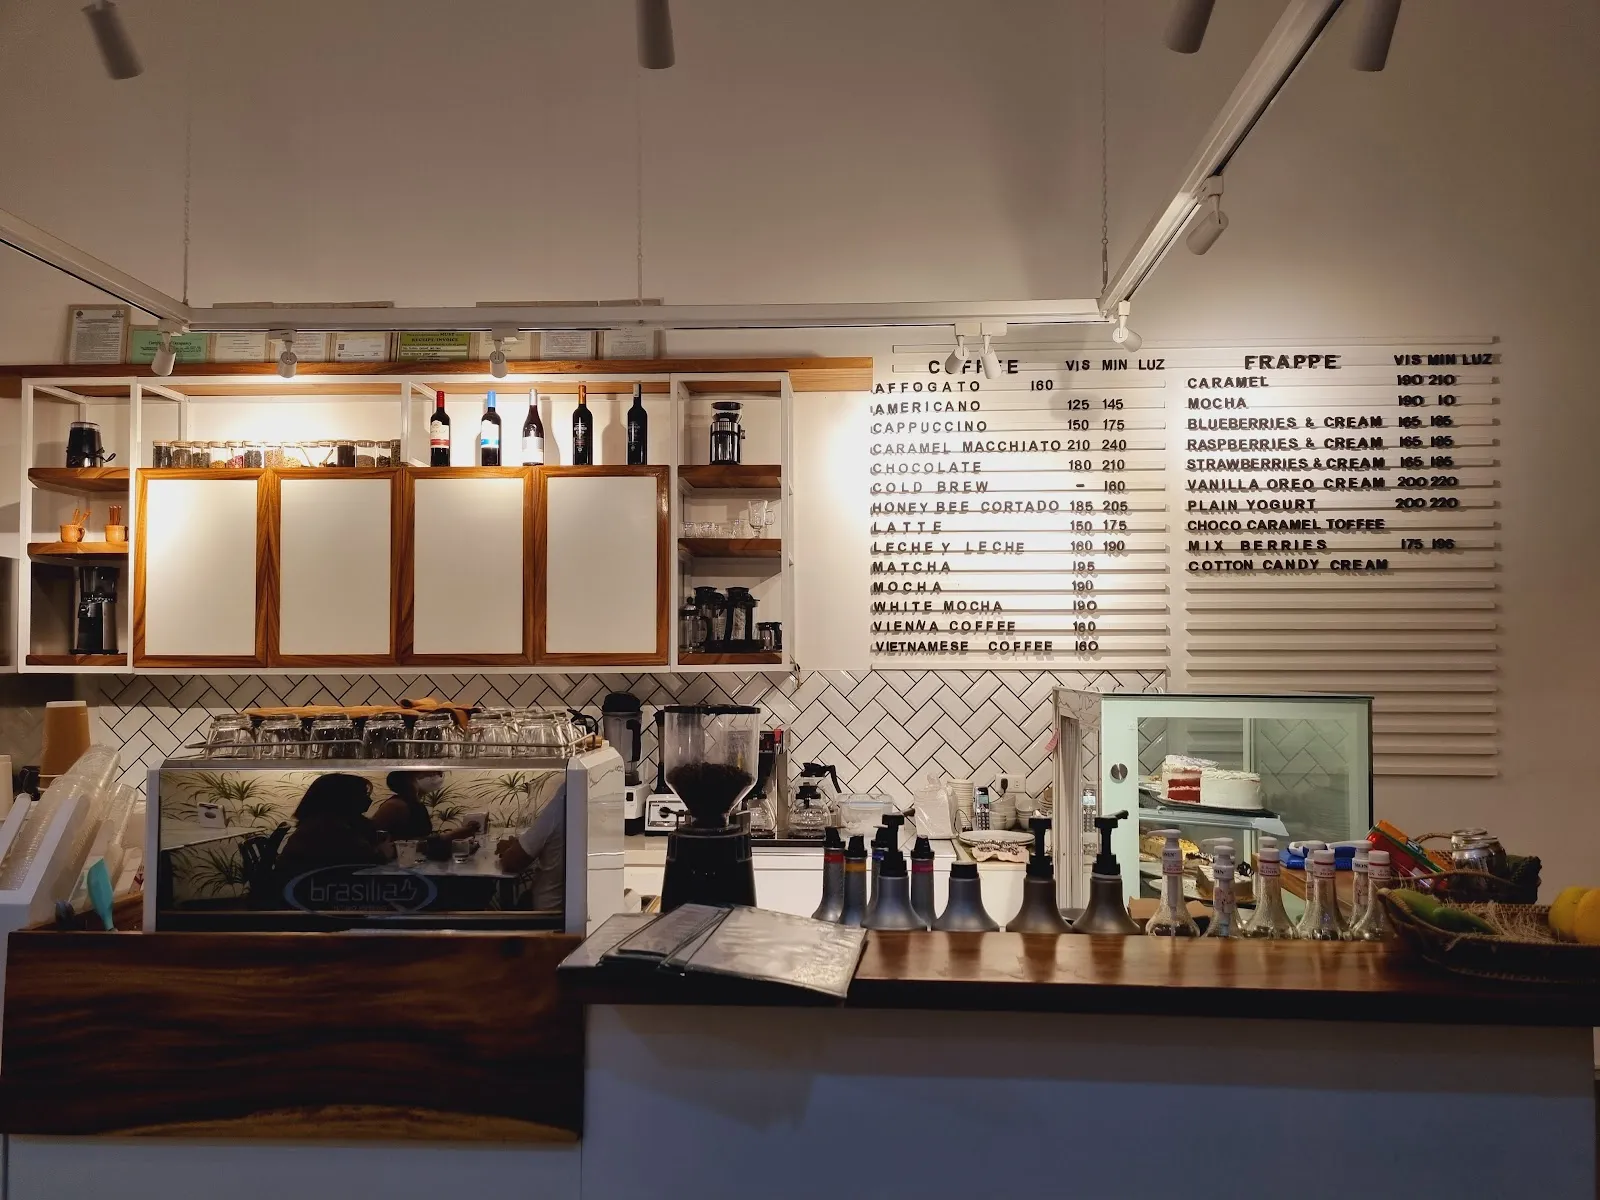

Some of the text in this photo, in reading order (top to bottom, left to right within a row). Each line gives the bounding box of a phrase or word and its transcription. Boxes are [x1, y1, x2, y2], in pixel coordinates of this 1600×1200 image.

[928, 358, 1166, 374] CFFE VIS MIN LUZ
[1244, 354, 1493, 369] FRAPPE VIS MIN LUZ
[875, 380, 1054, 394] AFFOGATO 160
[1187, 376, 1269, 388] CARAMEL
[1429, 374, 1456, 386] 210
[874, 399, 1124, 415] AMERICANO 125 145
[1188, 397, 1248, 410] MOCHA
[872, 419, 1125, 434] CAPPUCCINO 150 175
[1187, 417, 1297, 430] BLUEBERRIES
[1305, 417, 1315, 428] &
[1324, 416, 1383, 427] CREAM
[872, 440, 1127, 455] CARAMEL MACCHIATO 210 240
[1187, 438, 1299, 451] RASPBERRIES
[1306, 437, 1315, 448] &
[1324, 436, 1384, 449] CREAM
[872, 460, 1125, 474] CHOCOLATE 180 210
[1187, 457, 1308, 469] STRAWBERRIES
[1313, 457, 1322, 468] &
[1326, 457, 1385, 469] CREAM
[872, 482, 922, 494] COLD
[937, 481, 988, 492] BREW
[1104, 480, 1126, 492] 160
[1187, 476, 1458, 490] VANILLA OREO CREAM 200 220
[872, 500, 1128, 513] HONEY BEE CORTADO 185 205
[1187, 498, 1458, 511] PLAIN YOGURT 200 220
[872, 520, 1127, 534] LATTE 150 175
[1187, 518, 1385, 530] CHOCO CARAMEL TOFFEE
[966, 541, 1025, 553] LECHE
[1103, 540, 1125, 552] 190
[1189, 540, 1224, 551] MIX
[1240, 539, 1327, 551] BERRIES
[1401, 538, 1423, 550] 175
[872, 560, 1095, 572] MATCHA 195
[1189, 559, 1388, 572] COTTON CANDY CREAM
[872, 580, 1094, 592] MOCHA 190
[873, 600, 1097, 612] WHITE MOCHA 190
[873, 620, 1096, 632] VIENNA COFFEE 160
[876, 640, 1098, 652] VIETNAMESE COFFEE 160
[310, 877, 398, 901] brasilia
